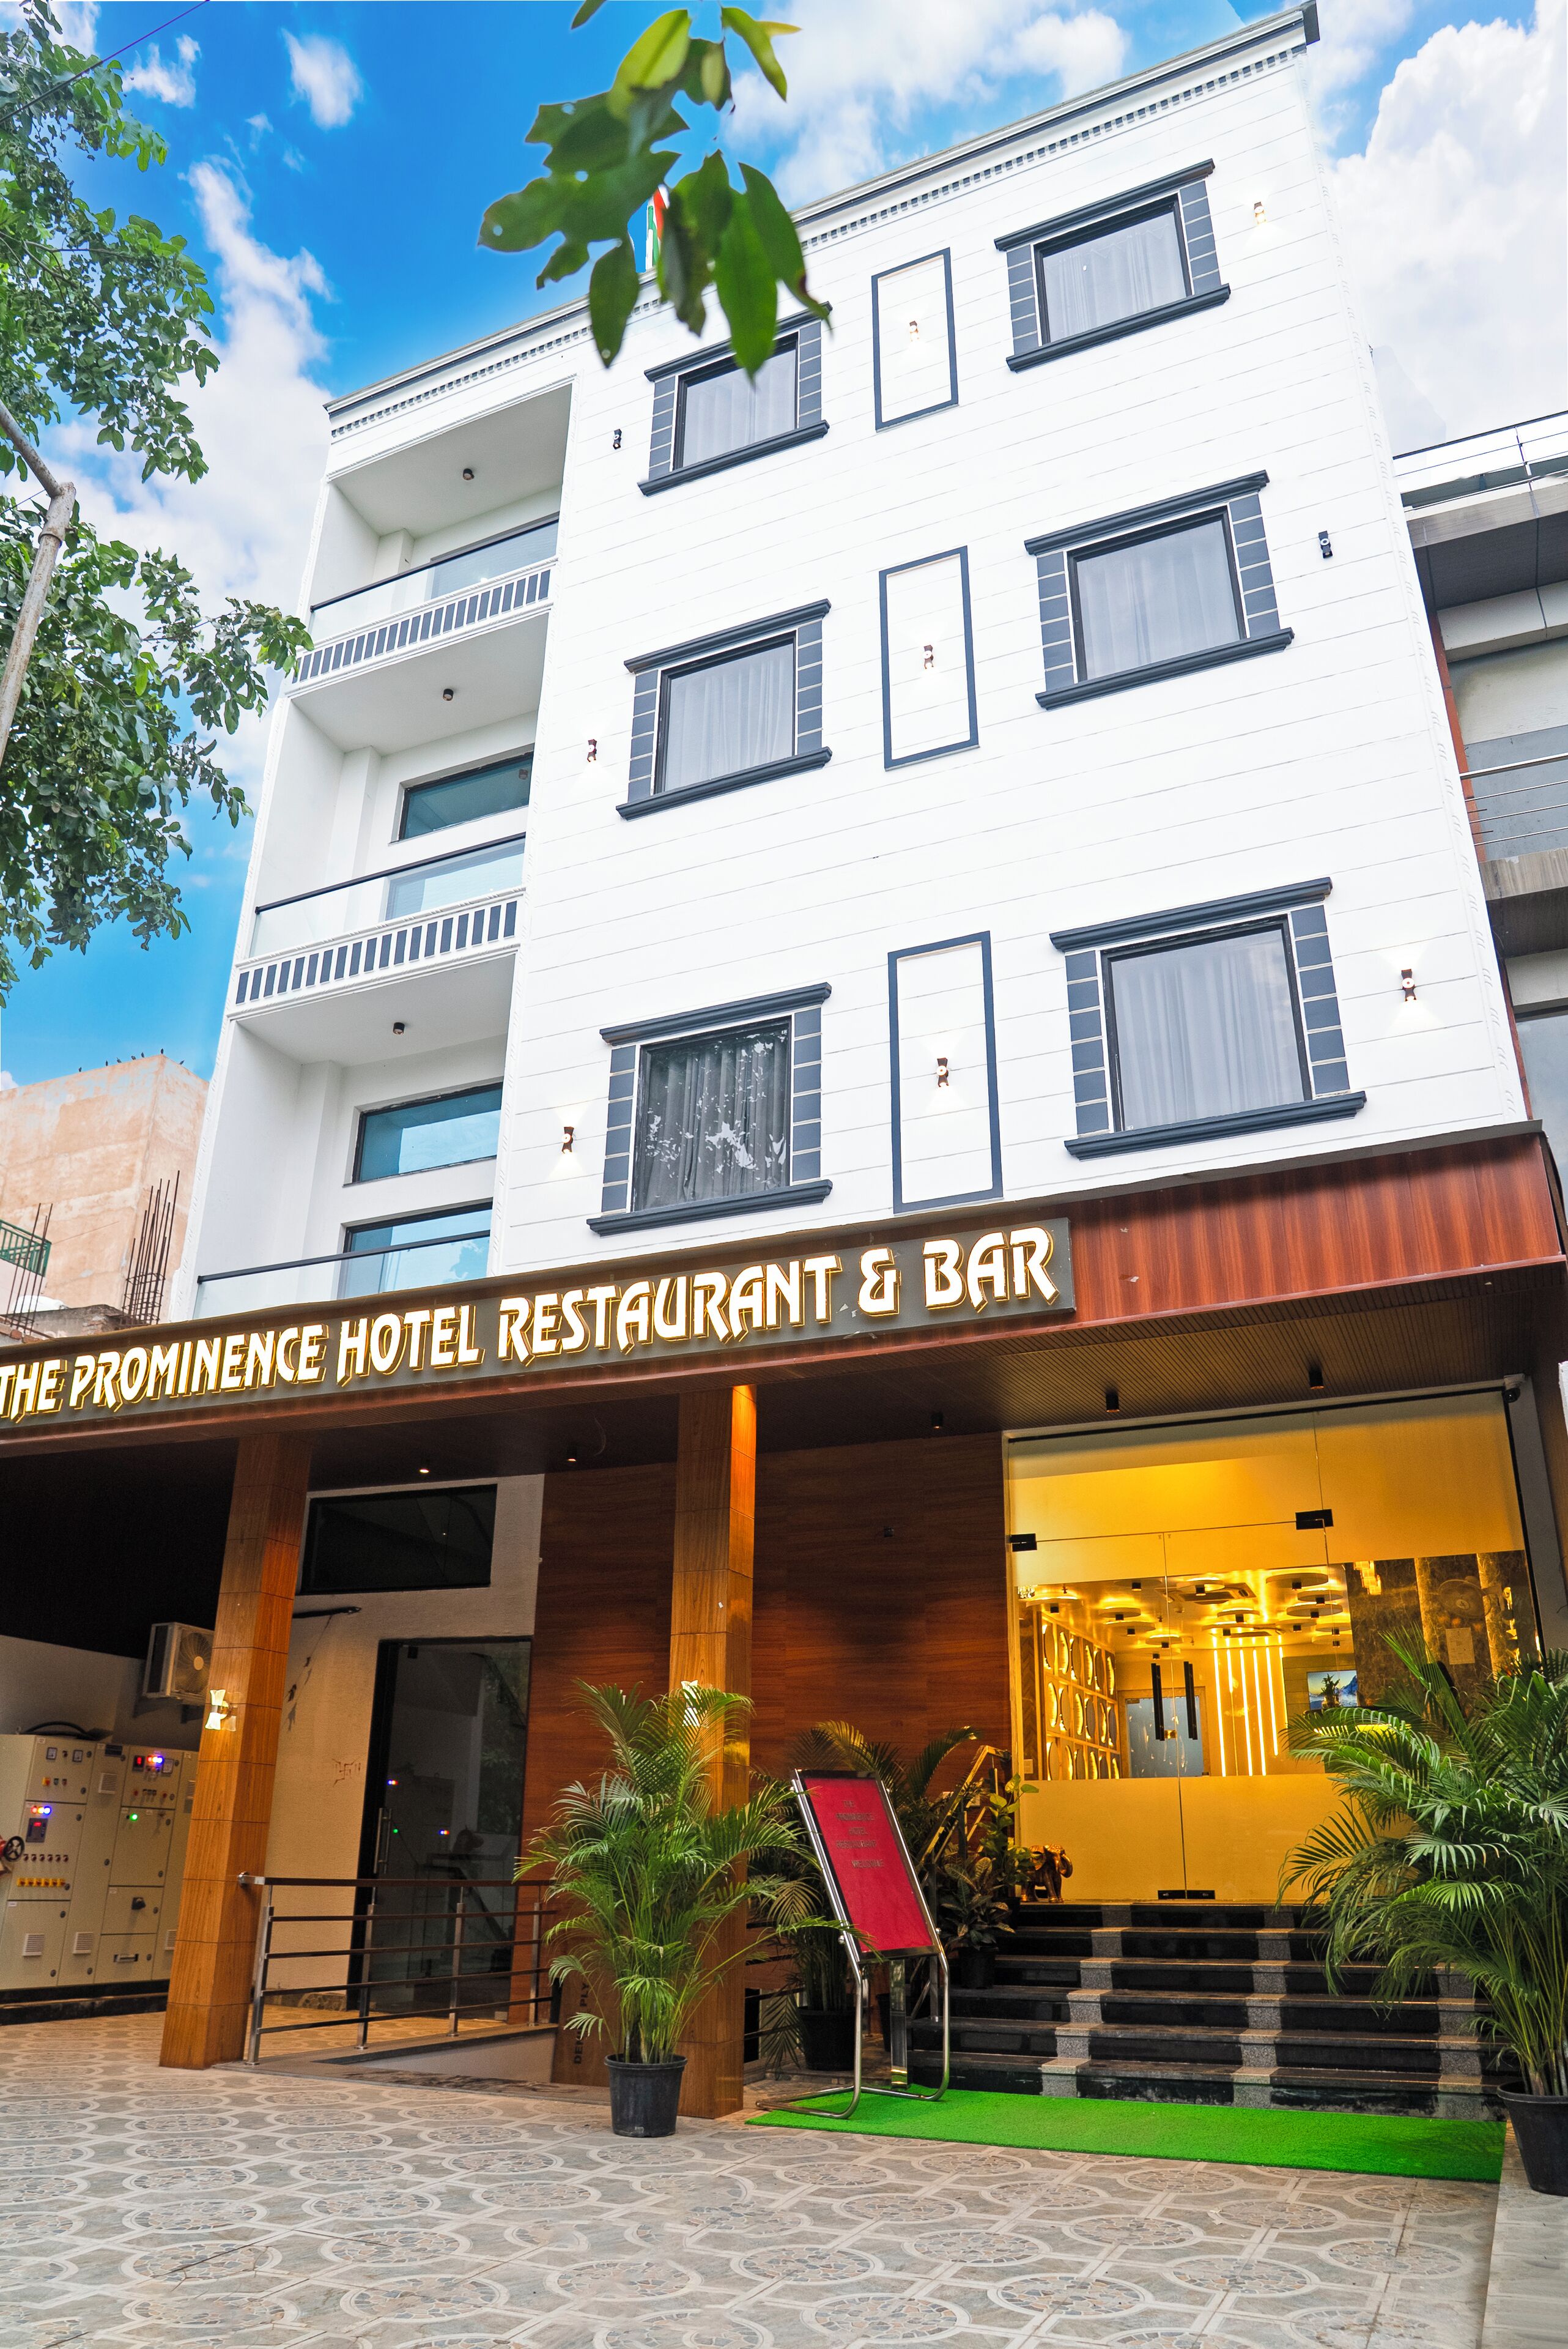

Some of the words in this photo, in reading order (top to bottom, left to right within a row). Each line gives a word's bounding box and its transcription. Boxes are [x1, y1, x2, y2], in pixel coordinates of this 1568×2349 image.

[0, 1359, 65, 1422] THE
[68, 1323, 327, 1410] PROMINENCE
[336, 1304, 483, 1385] HOTEL
[498, 1254, 840, 1364] RESTAURANT
[857, 1247, 898, 1315] &
[923, 1226, 1059, 1310] BAR
[580, 1982, 589, 2007] PLY
